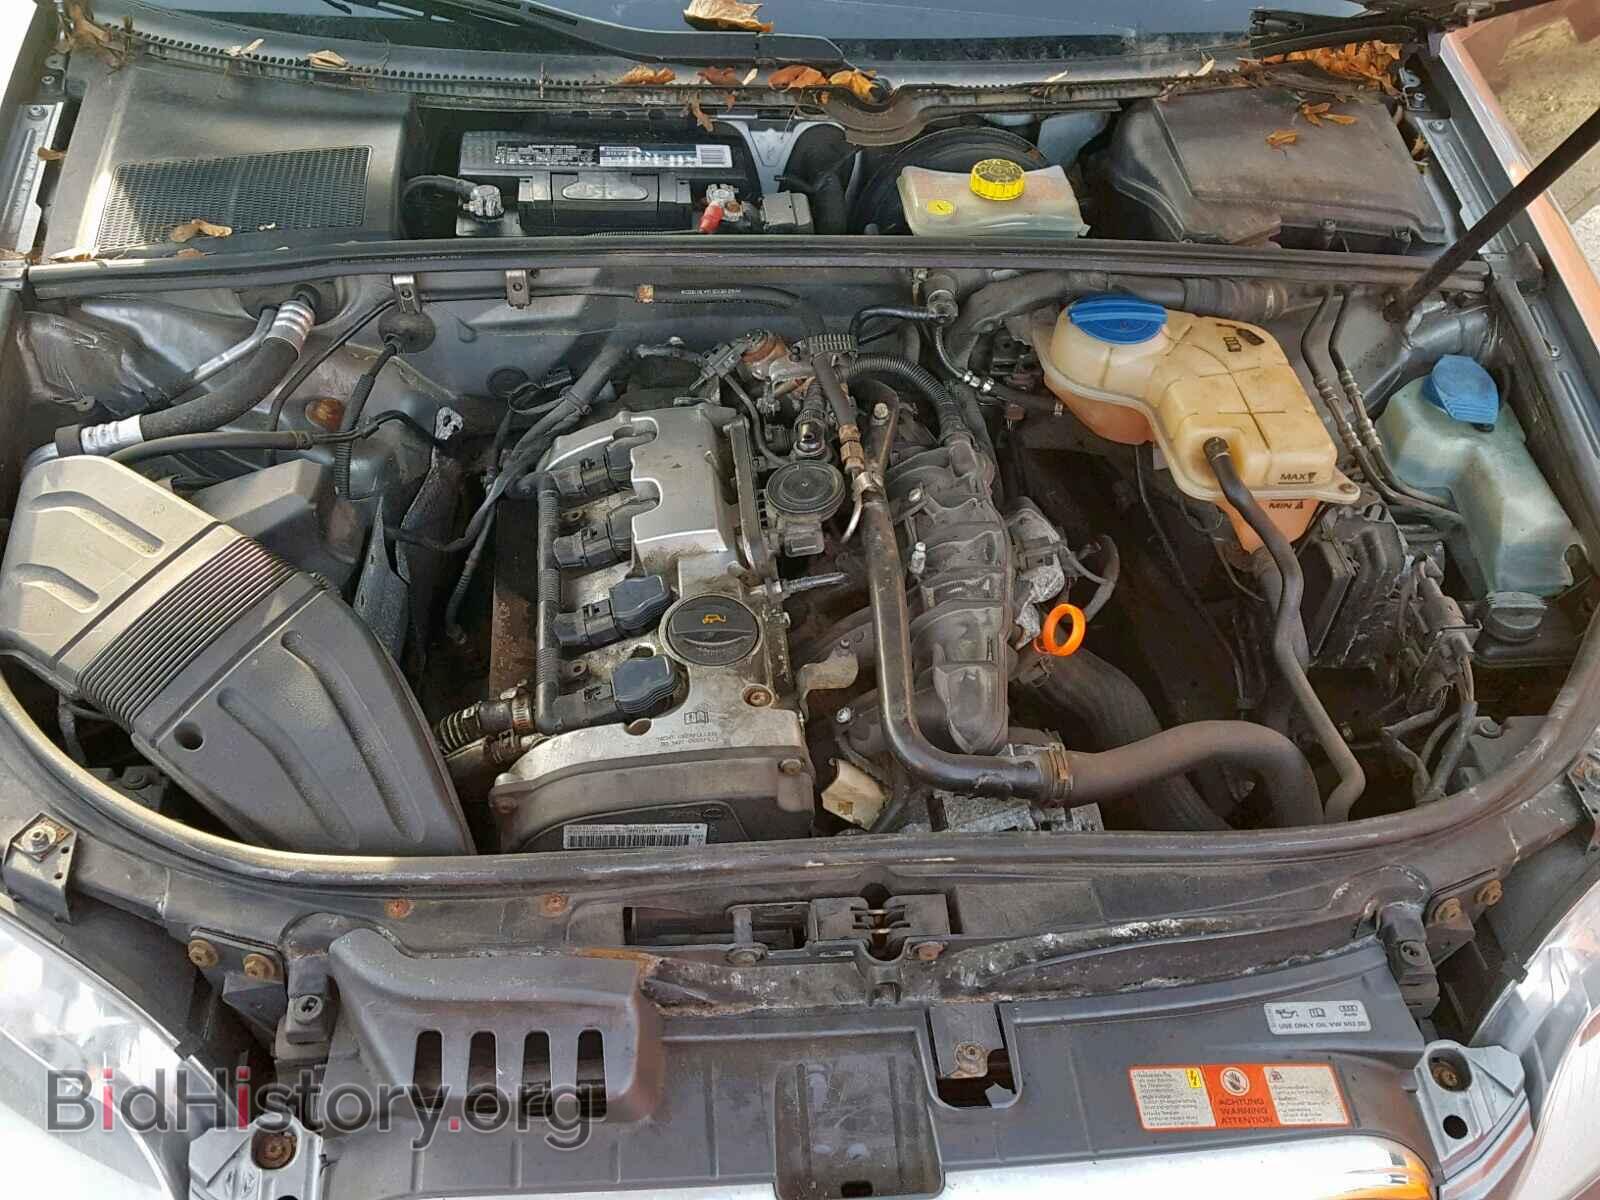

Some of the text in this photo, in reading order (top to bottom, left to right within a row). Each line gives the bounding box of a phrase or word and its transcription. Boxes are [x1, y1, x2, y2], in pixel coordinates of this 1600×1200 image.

[1219, 1098, 1265, 1106] ACHTUNG
[1220, 1107, 1268, 1115] WARNING
[1221, 1116, 1273, 1125] ATTENTION
